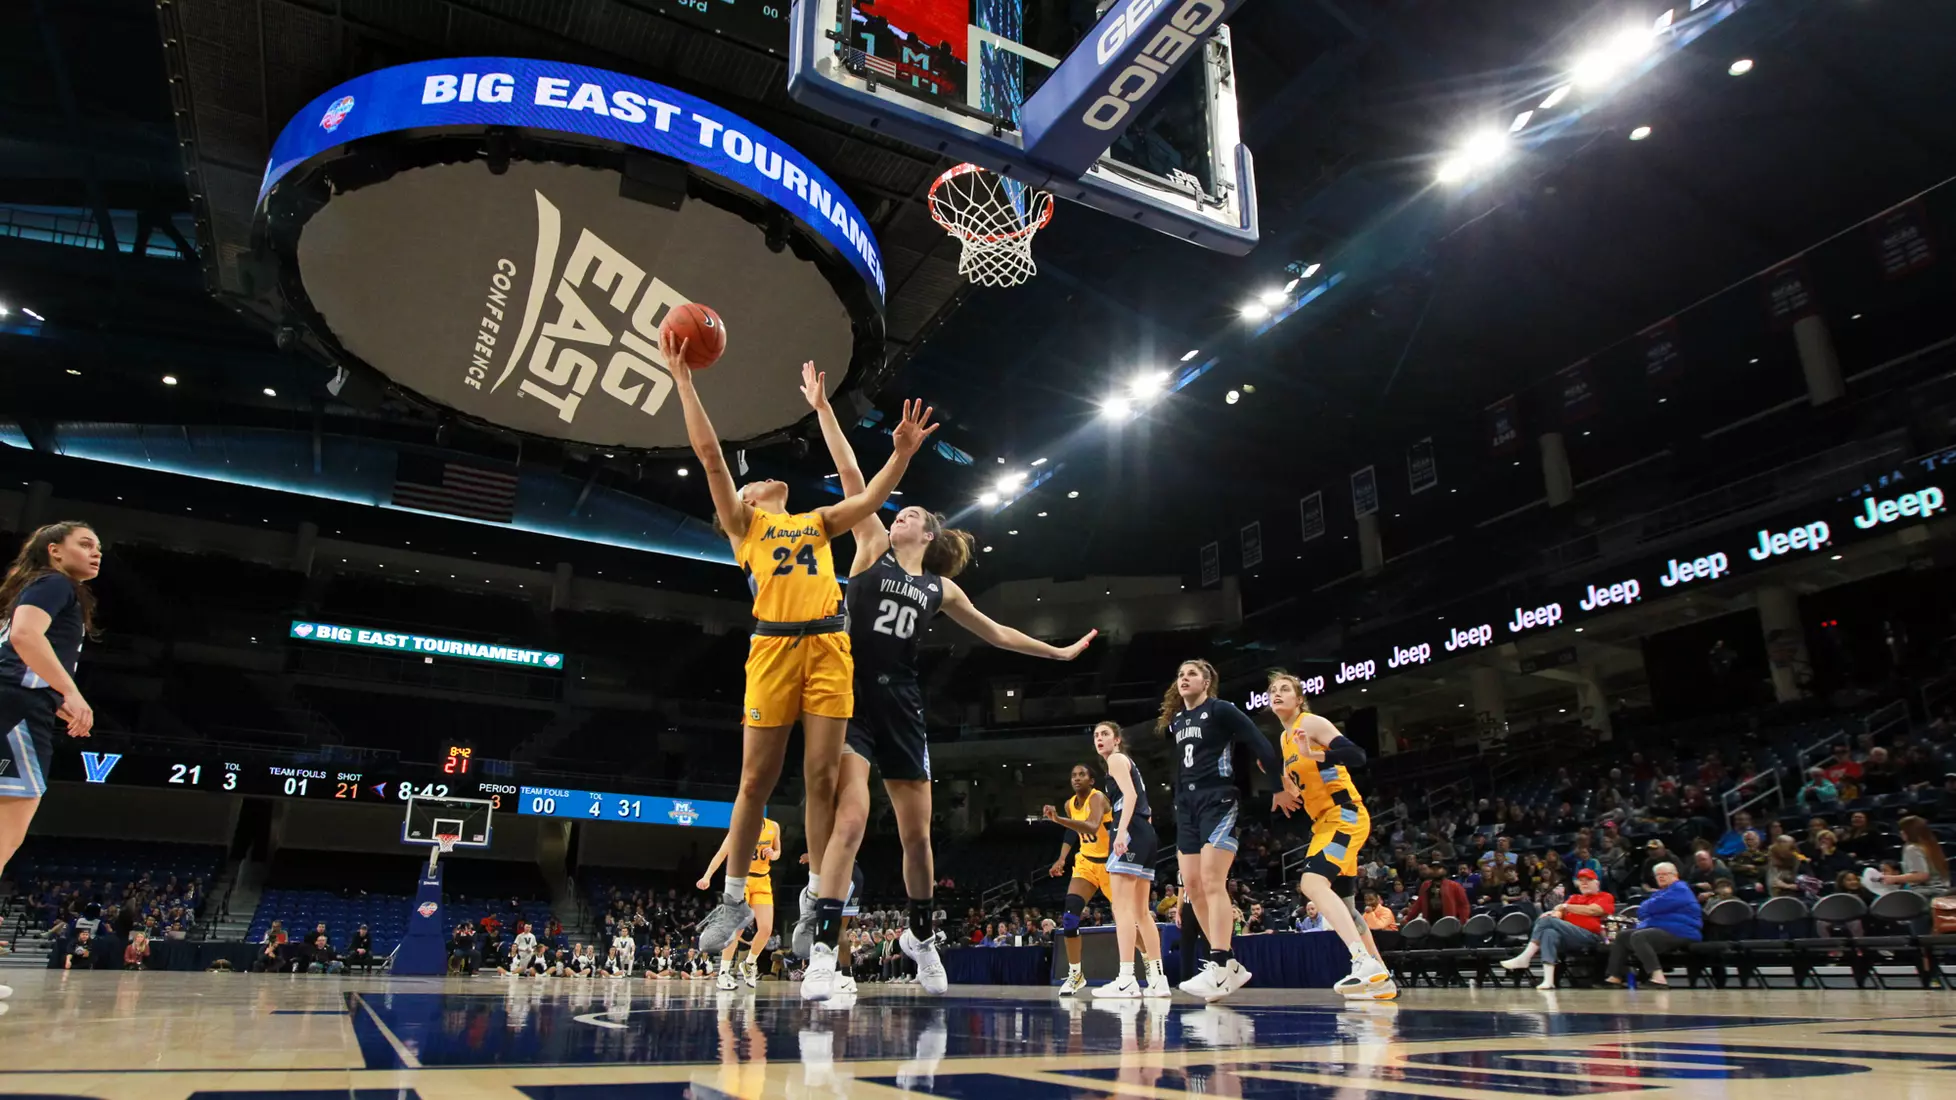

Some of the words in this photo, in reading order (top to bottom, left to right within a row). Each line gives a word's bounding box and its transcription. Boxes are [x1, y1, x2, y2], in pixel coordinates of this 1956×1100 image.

[1082, 0, 1225, 131] GEICO
[422, 72, 515, 105] BIG
[534, 77, 681, 132] EAST
[464, 258, 517, 391] CONFERENCE
[520, 227, 647, 424] EAST
[601, 277, 694, 417] BIG
[772, 544, 818, 576] 24
[880, 577, 929, 610] VILLANOVA
[1245, 691, 1269, 711] Jee
[1299, 675, 1325, 695] eep
[1336, 659, 1375, 684] Jeep
[1388, 643, 1430, 668] Jeep
[1445, 623, 1491, 651] Jeep
[1509, 602, 1562, 632] Jeep
[1580, 579, 1641, 611] Jeep
[1660, 551, 1729, 587] Jeep
[1749, 520, 1831, 561] Jeep
[1854, 486, 1945, 529] Jeep
[873, 599, 919, 640] 20
[317, 625, 352, 641] BIG
[357, 631, 409, 648] EAST
[413, 637, 543, 664] TOURNAMENT
[1176, 727, 1203, 744] VILLANOVA
[449, 747, 472, 758] 8:42
[81, 751, 122, 783] V
[224, 762, 241, 771] TOL
[269, 766, 295, 777] TEAM
[296, 769, 327, 779] FOULS
[444, 757, 468, 773] 21
[168, 764, 201, 785] 21
[223, 773, 237, 790] 3
[337, 773, 362, 782] SHOT
[284, 778, 308, 796] 01
[335, 783, 358, 799] 21
[398, 781, 449, 799] 8:42
[479, 783, 517, 795] PERIOD
[520, 786, 543, 796] TEAM
[544, 788, 570, 798] FOULS
[590, 792, 603, 800] TOL
[492, 795, 501, 809] 3
[532, 798, 555, 814] 00
[589, 801, 600, 817] 4
[618, 799, 641, 818] 31
